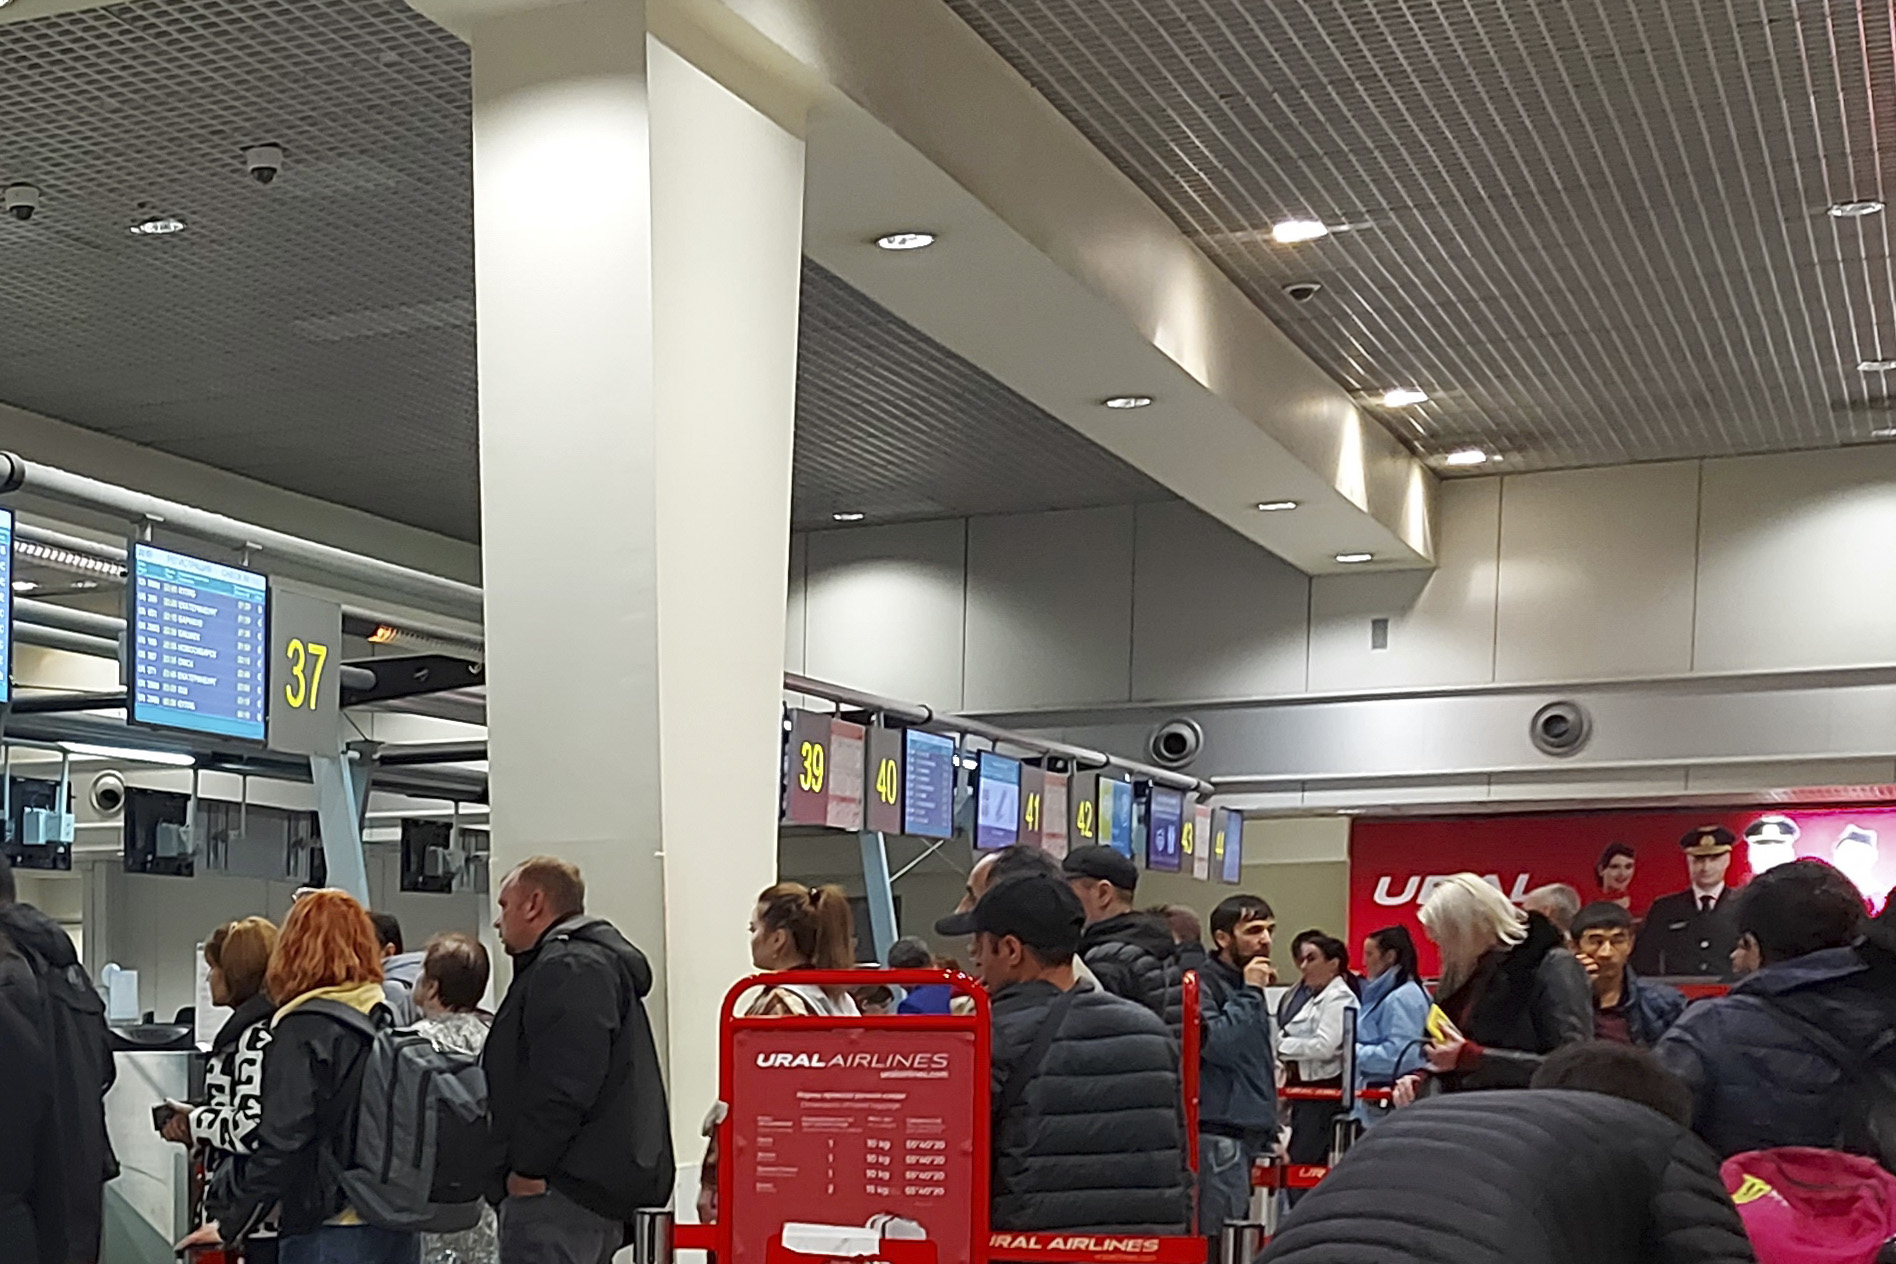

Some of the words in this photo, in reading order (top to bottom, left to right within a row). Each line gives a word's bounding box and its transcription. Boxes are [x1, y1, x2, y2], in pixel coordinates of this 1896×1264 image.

[285, 638, 328, 711] 37
[799, 741, 824, 793] 39
[875, 758, 898, 805] 40
[1025, 792, 1040, 832] 41
[1076, 800, 1093, 838] 42
[756, 1053, 826, 1069] URAL
[826, 1053, 949, 1069] AIRLINES
[1046, 1237, 1160, 1253] AIRLINES
